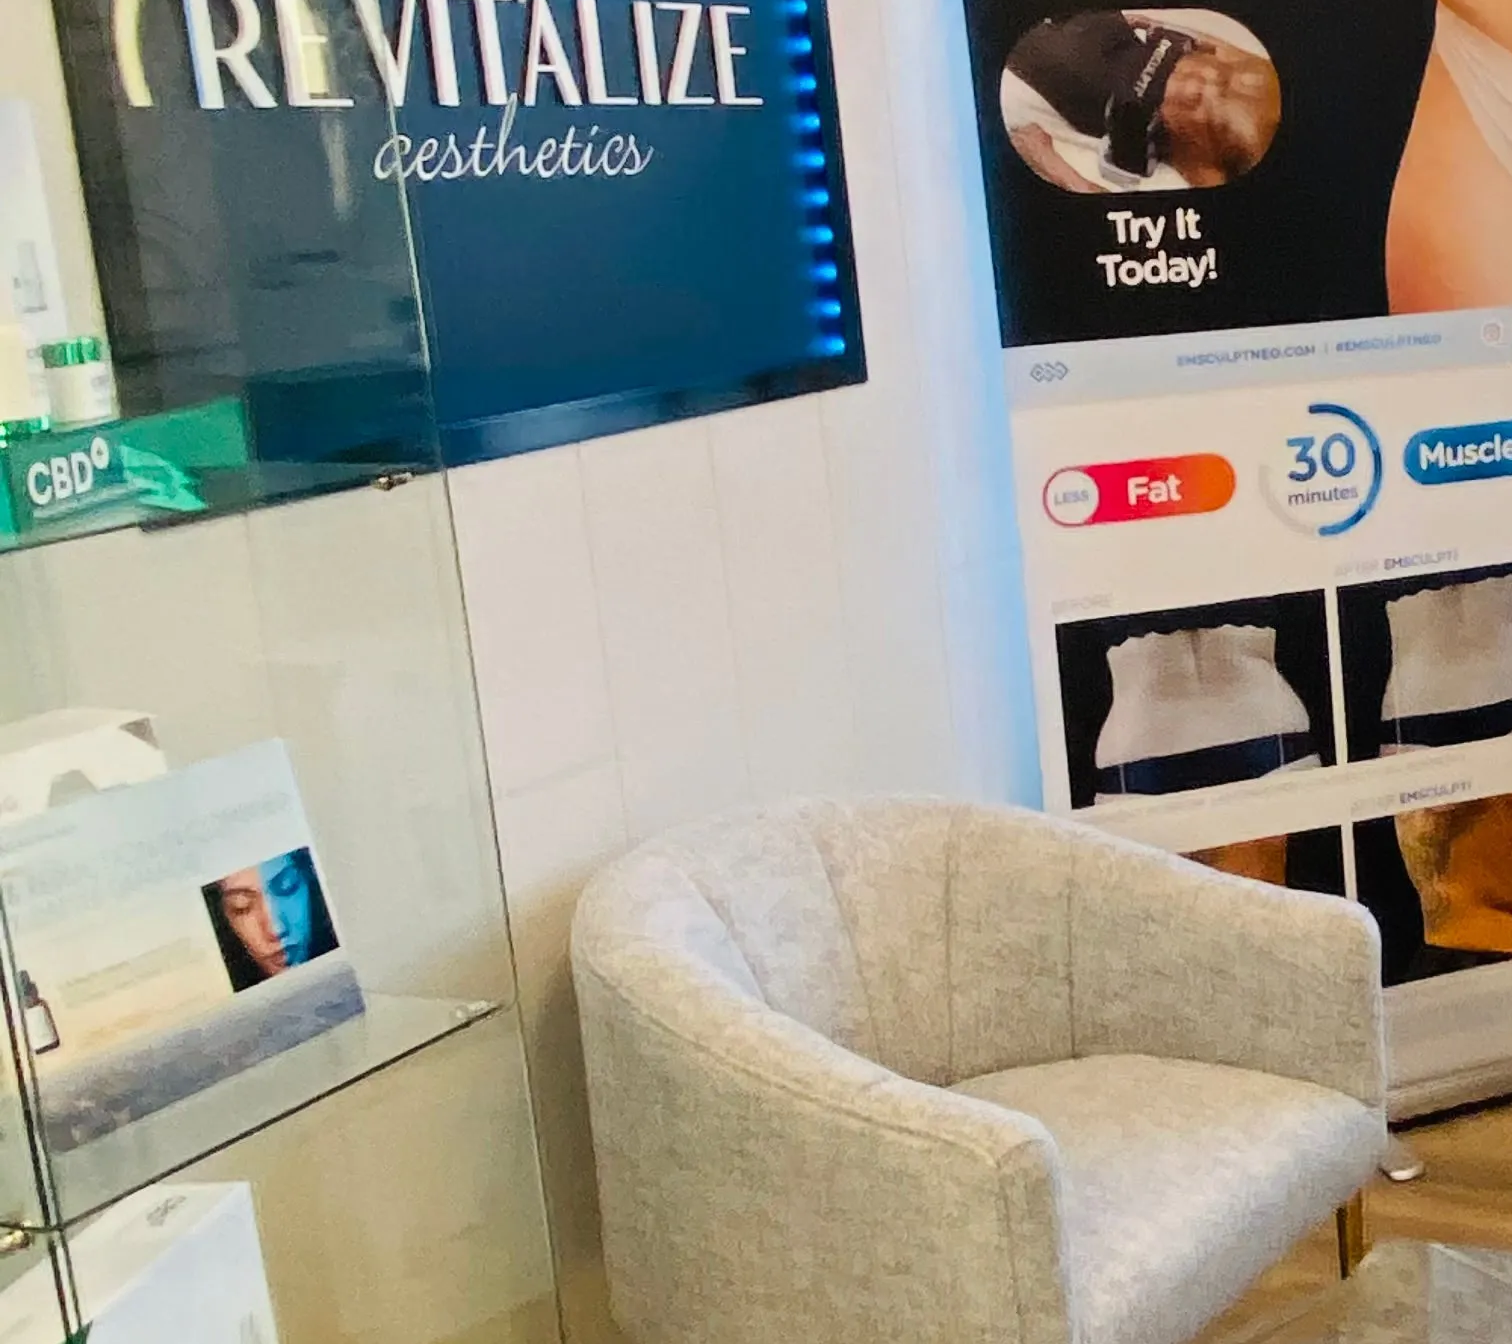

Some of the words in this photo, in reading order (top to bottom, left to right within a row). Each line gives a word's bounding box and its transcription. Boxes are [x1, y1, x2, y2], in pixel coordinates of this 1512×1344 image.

[373, 91, 654, 182] aesthetics
[1107, 210, 1166, 249] Try
[1176, 207, 1202, 240] It
[1096, 247, 1218, 288] Today!
[1286, 432, 1357, 483] 30
[1054, 488, 1090, 506] LESS
[1127, 473, 1183, 506] Fat
[1288, 485, 1360, 507] minutes
